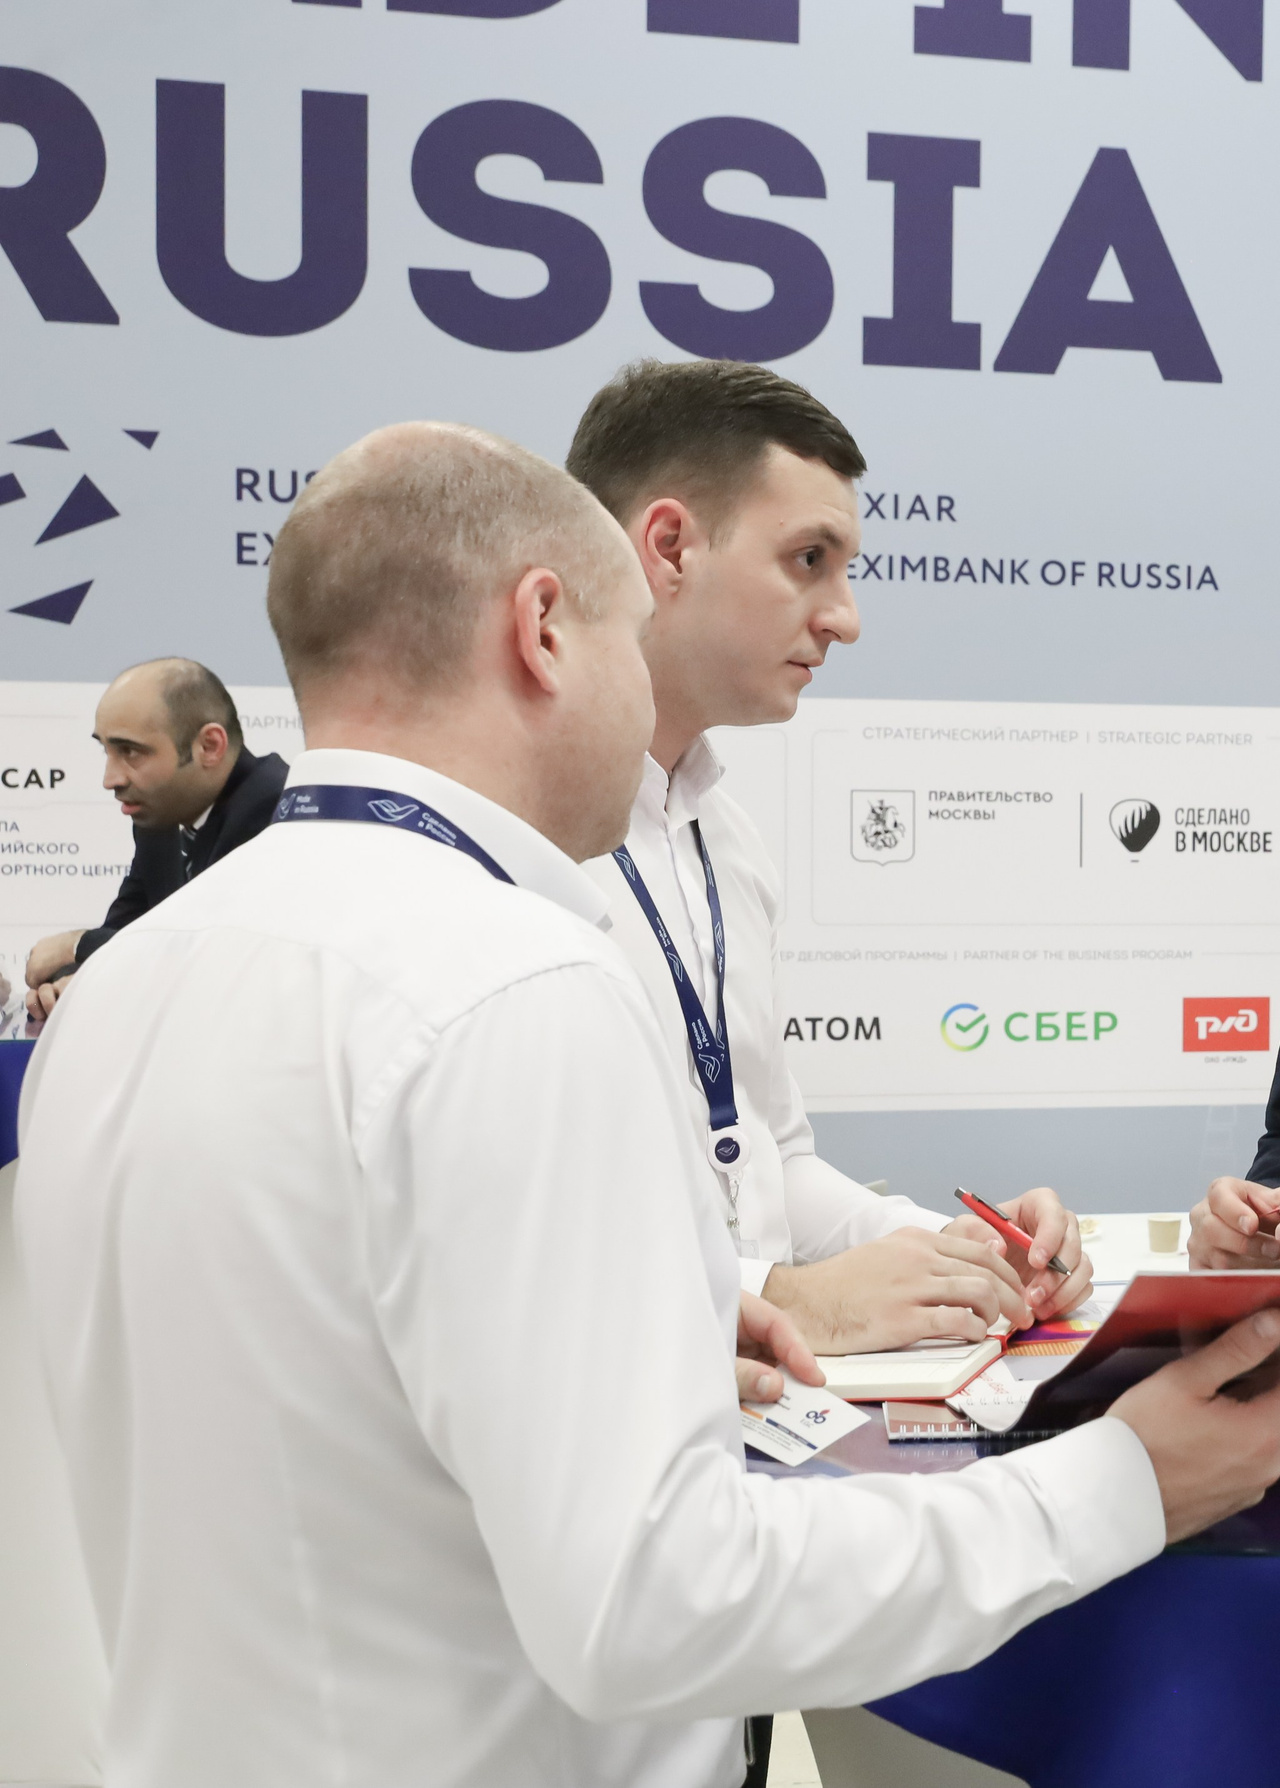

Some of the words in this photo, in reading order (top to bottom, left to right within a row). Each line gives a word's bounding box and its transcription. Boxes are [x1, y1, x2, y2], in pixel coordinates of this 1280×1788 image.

[1040, 559, 1087, 587] OF
[1097, 561, 1220, 592] RUSSIA
[861, 725, 1005, 743] СТРАТЕГИЧЕСКИЙ
[1009, 728, 1079, 743] ПАРТНЕР
[1097, 730, 1182, 745] STRATEGIC
[1185, 732, 1254, 746] PARTNER
[928, 789, 1054, 803] ПРАВИТЕЛЬСТВО
[928, 808, 996, 821] МОСКВЫ
[1174, 807, 1250, 828] СДЕЛАНО
[1, 840, 80, 855] ИЙСКОГО
[1175, 830, 1187, 853] В
[1191, 830, 1273, 853] МОСКВЕ
[1, 863, 79, 877] ОРТНОГО
[797, 948, 862, 963] ДЕЛОВОЙ
[865, 949, 949, 962] ПРОГРАММЫ
[963, 949, 1020, 962] PARTNER
[1022, 949, 1040, 962] OF
[1042, 949, 1064, 962] THE
[1067, 949, 1129, 962] BUSINESS
[1131, 949, 1193, 961] PROGRAM
[783, 1016, 882, 1042] АТОМ
[1003, 1010, 1118, 1042] СБЕР
